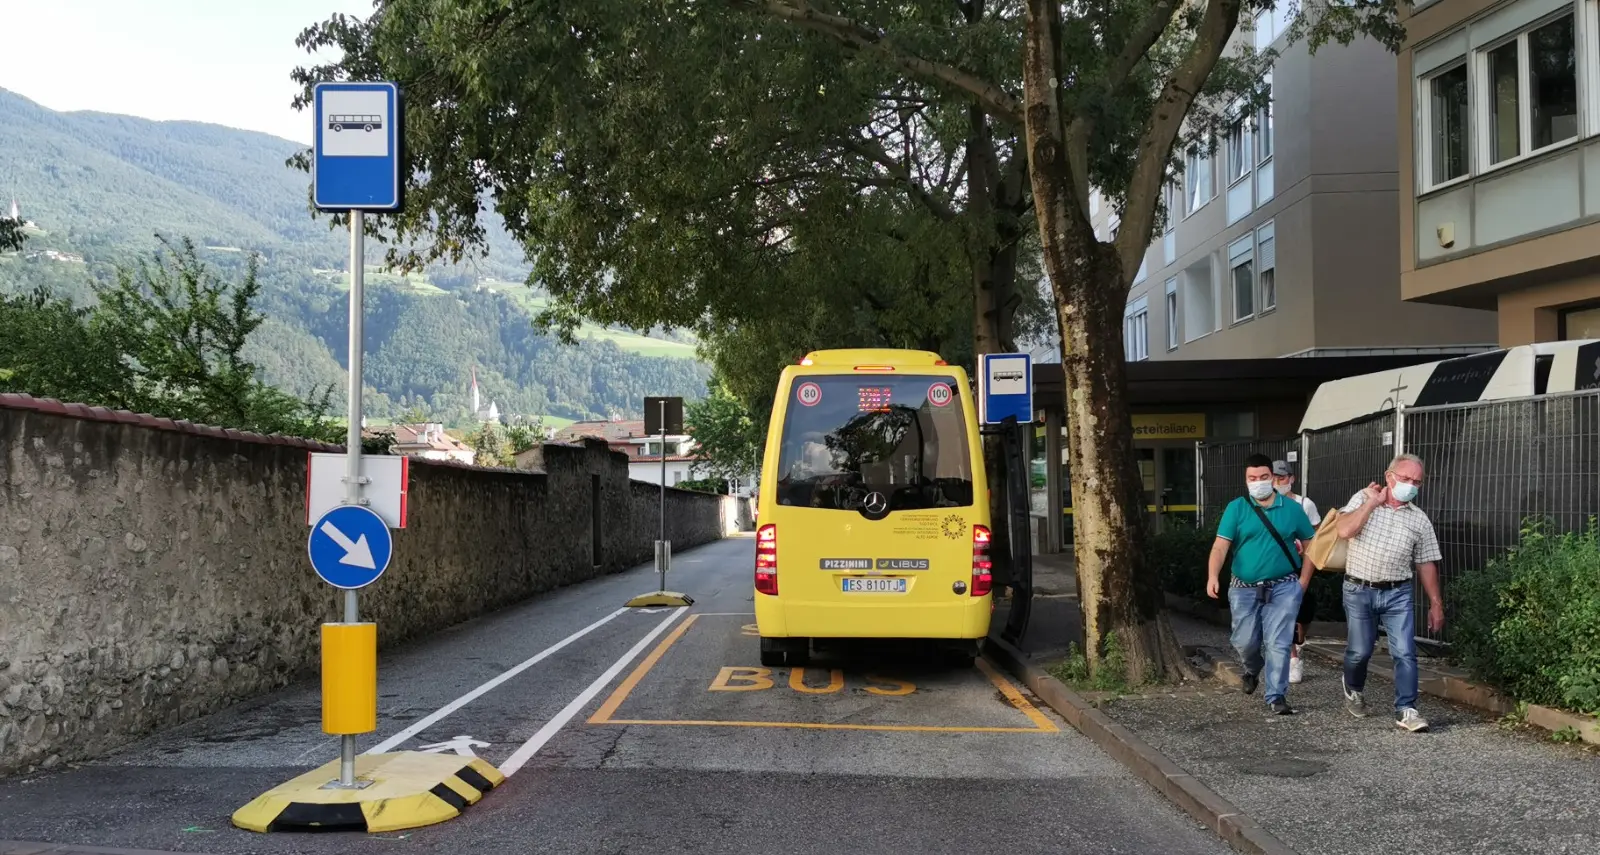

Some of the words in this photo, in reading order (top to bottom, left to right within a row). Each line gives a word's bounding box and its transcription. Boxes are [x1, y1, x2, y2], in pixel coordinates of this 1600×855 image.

[803, 389, 816, 399] 80
[932, 389, 948, 399] 100
[1131, 422, 1197, 435] osteitaliane
[824, 559, 868, 569] PIZZININI
[891, 560, 928, 569] LIBUS
[849, 580, 863, 591] ES
[866, 580, 899, 591] 810TJ
[708, 666, 917, 696] BUS
